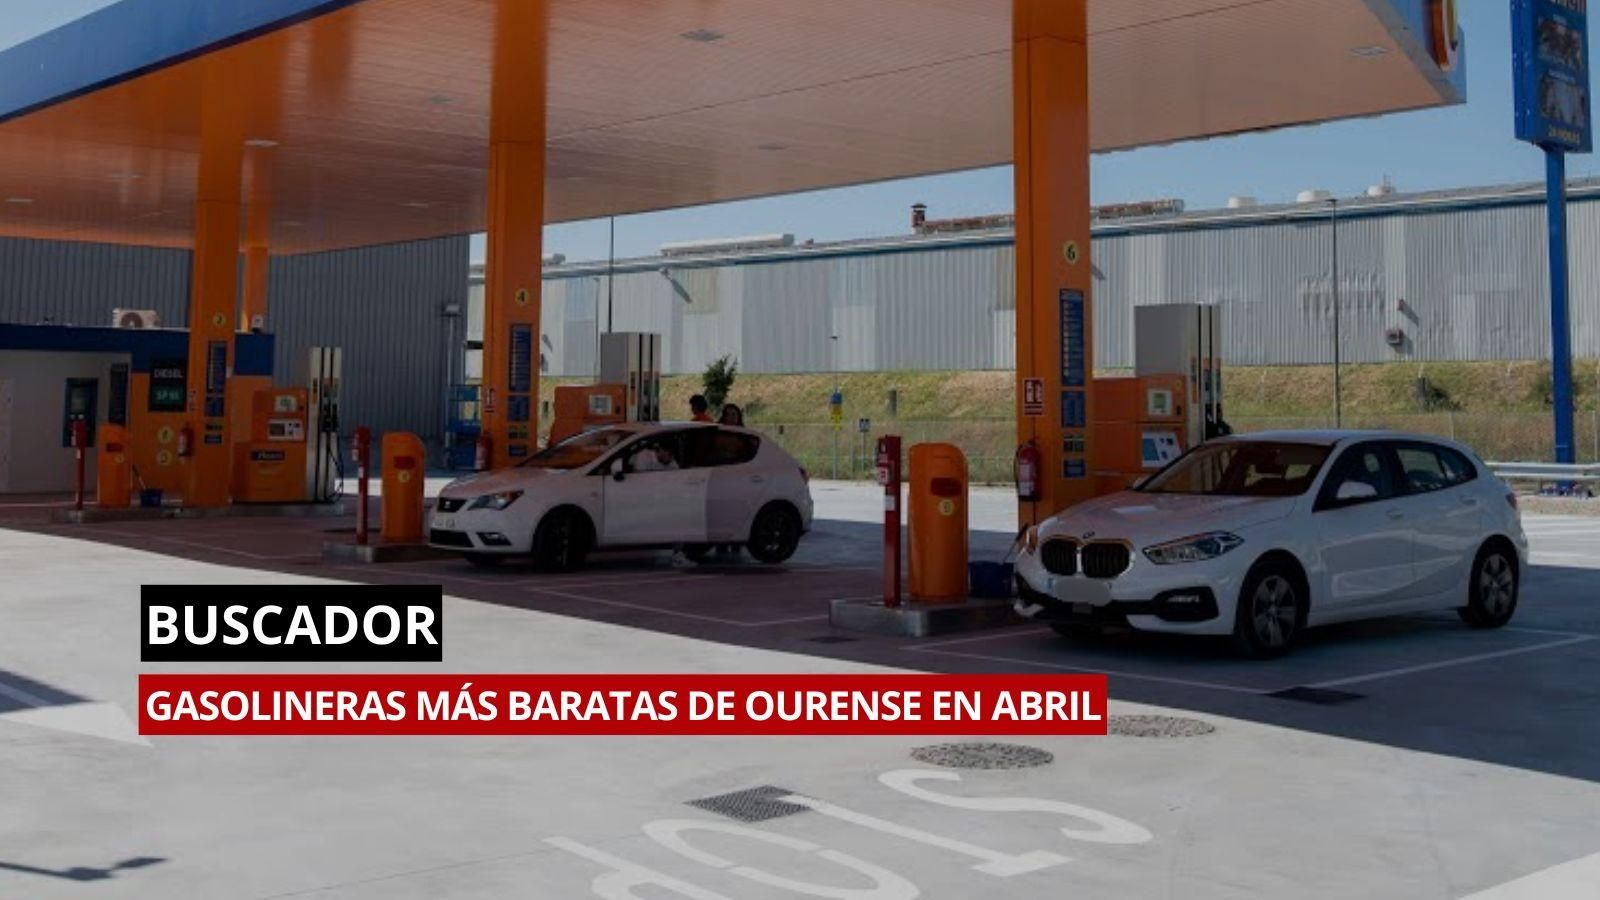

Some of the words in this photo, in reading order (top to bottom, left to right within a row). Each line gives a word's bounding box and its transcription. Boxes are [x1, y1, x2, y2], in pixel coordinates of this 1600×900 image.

[1066, 244, 1076, 261] 6
[517, 291, 526, 303] 4
[154, 367, 183, 379] DIESEL
